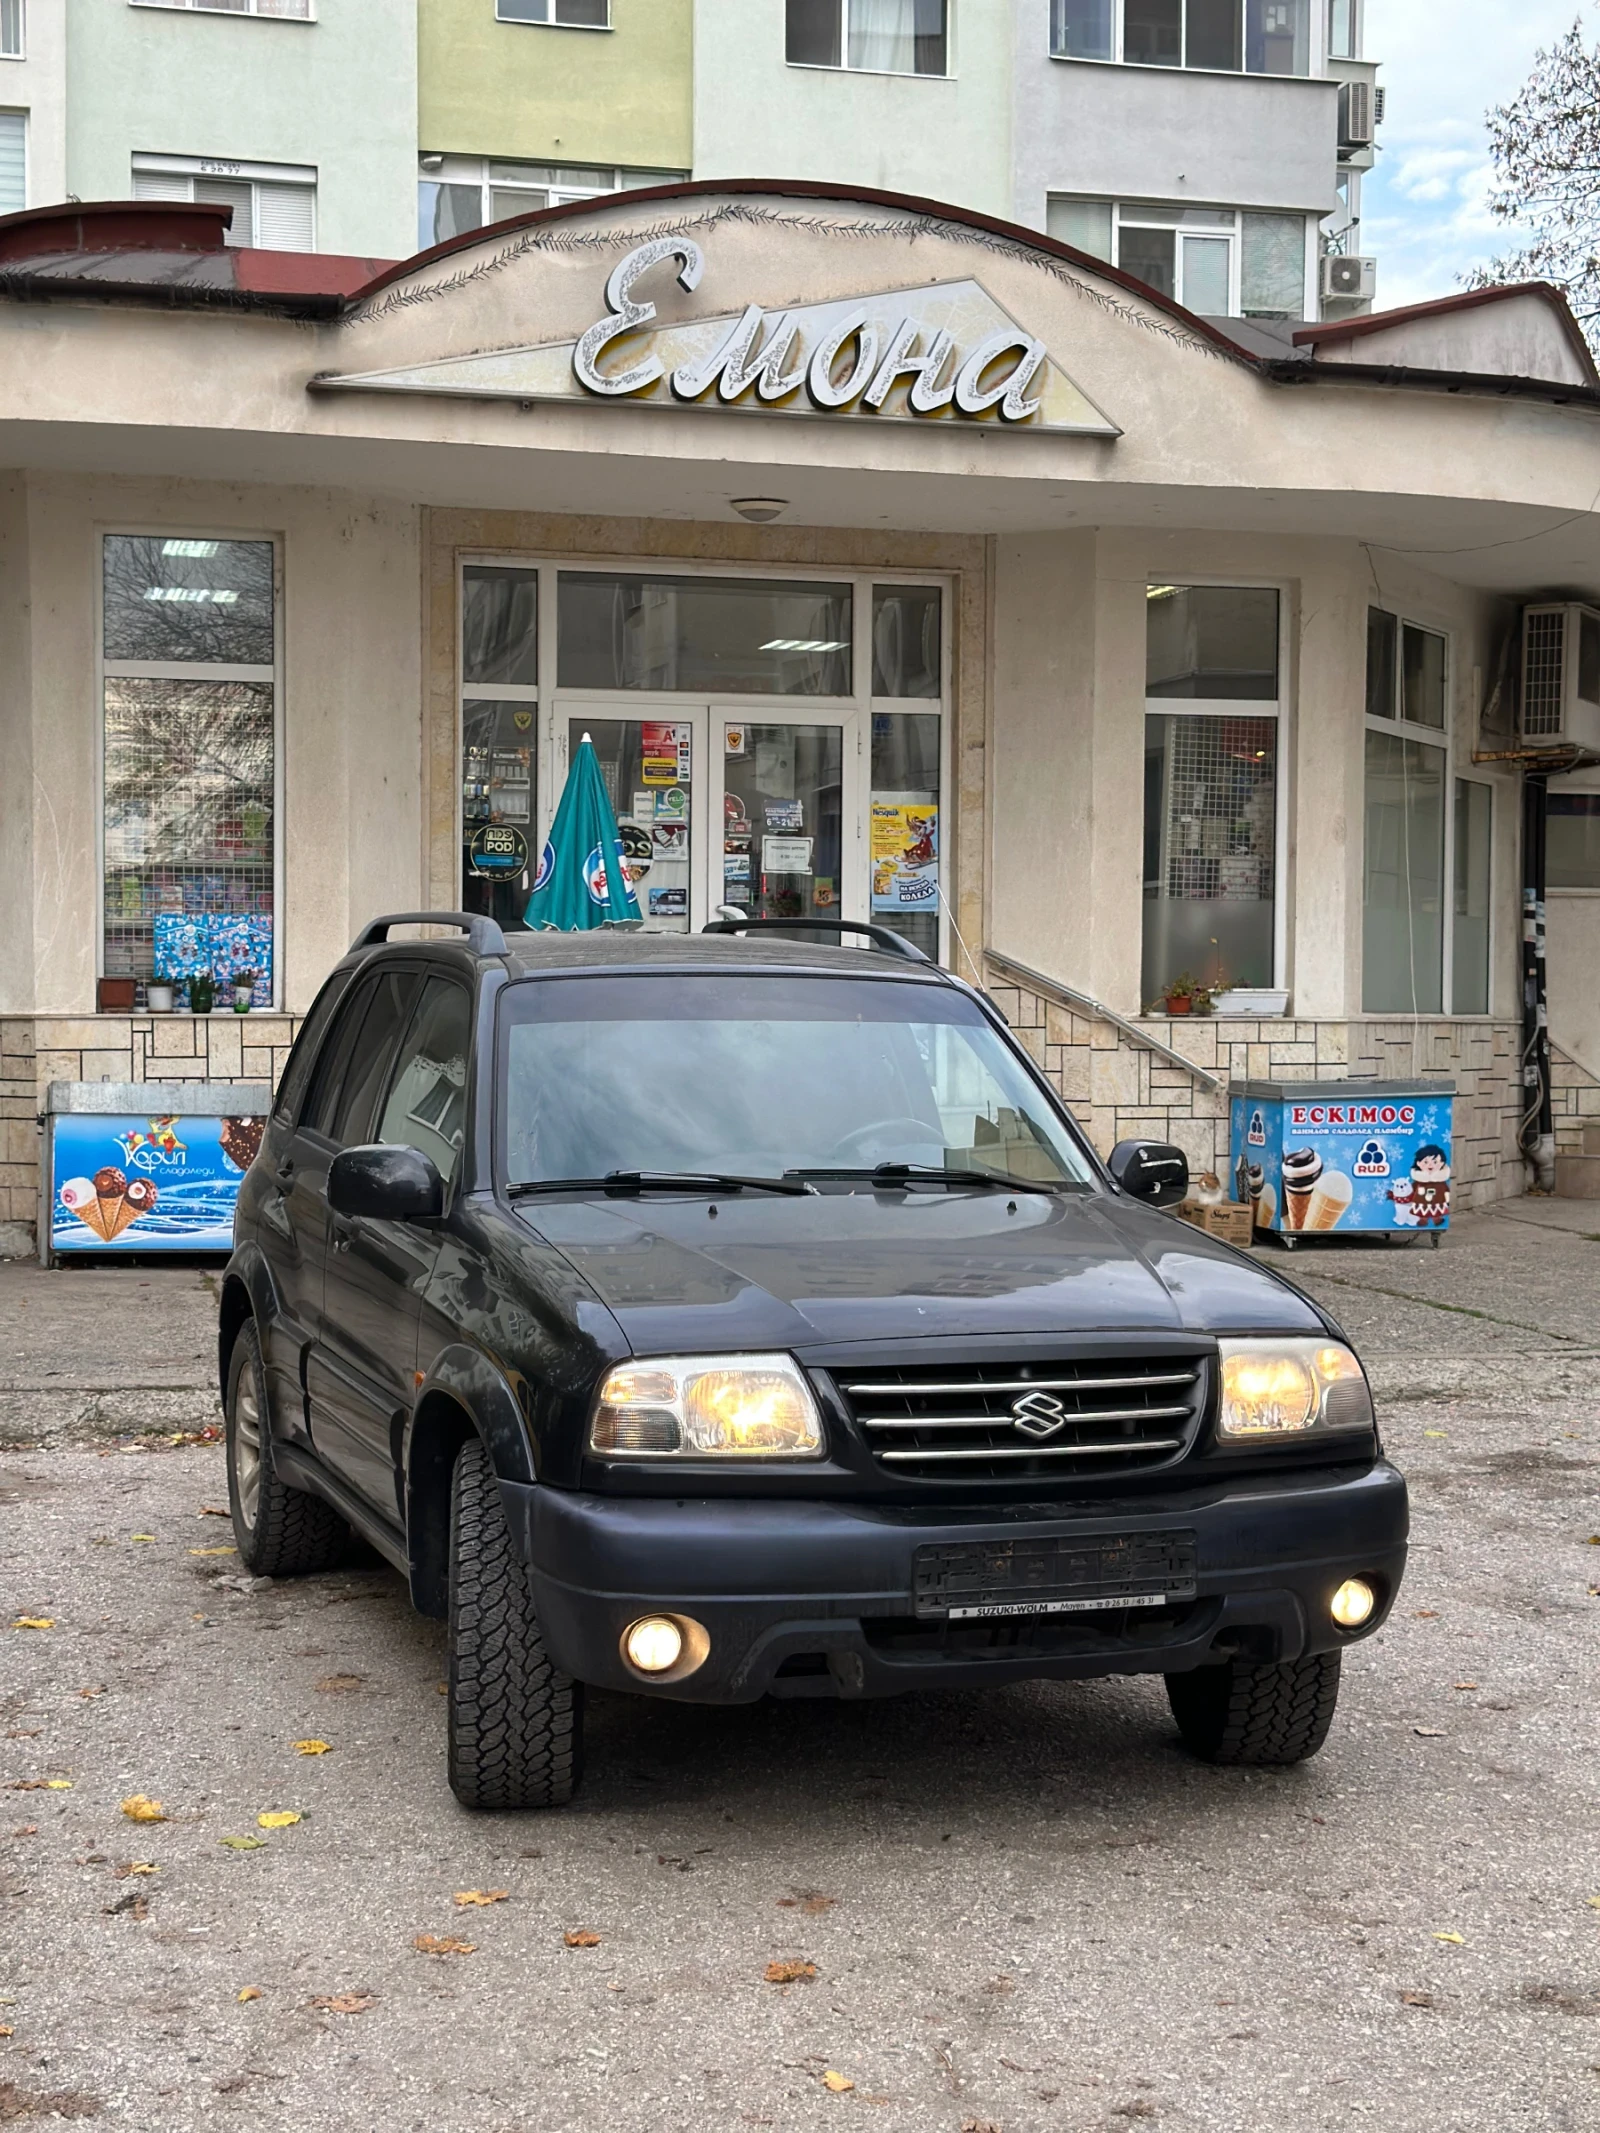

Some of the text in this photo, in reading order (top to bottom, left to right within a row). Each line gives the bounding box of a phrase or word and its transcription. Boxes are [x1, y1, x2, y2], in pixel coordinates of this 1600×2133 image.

[573, 236, 1049, 423] Емона
[872, 808, 899, 818] Nesquik
[486, 841, 512, 852] POD
[900, 888, 934, 901] КОЛЕДА
[1249, 1133, 1264, 1143] RUD
[159, 1167, 215, 1177] сладоледи
[1357, 1164, 1385, 1173] RUD
[1060, 1601, 1086, 1612] Mayen
[1112, 1599, 1121, 1607] 26
[1137, 1597, 1145, 1605] 45
